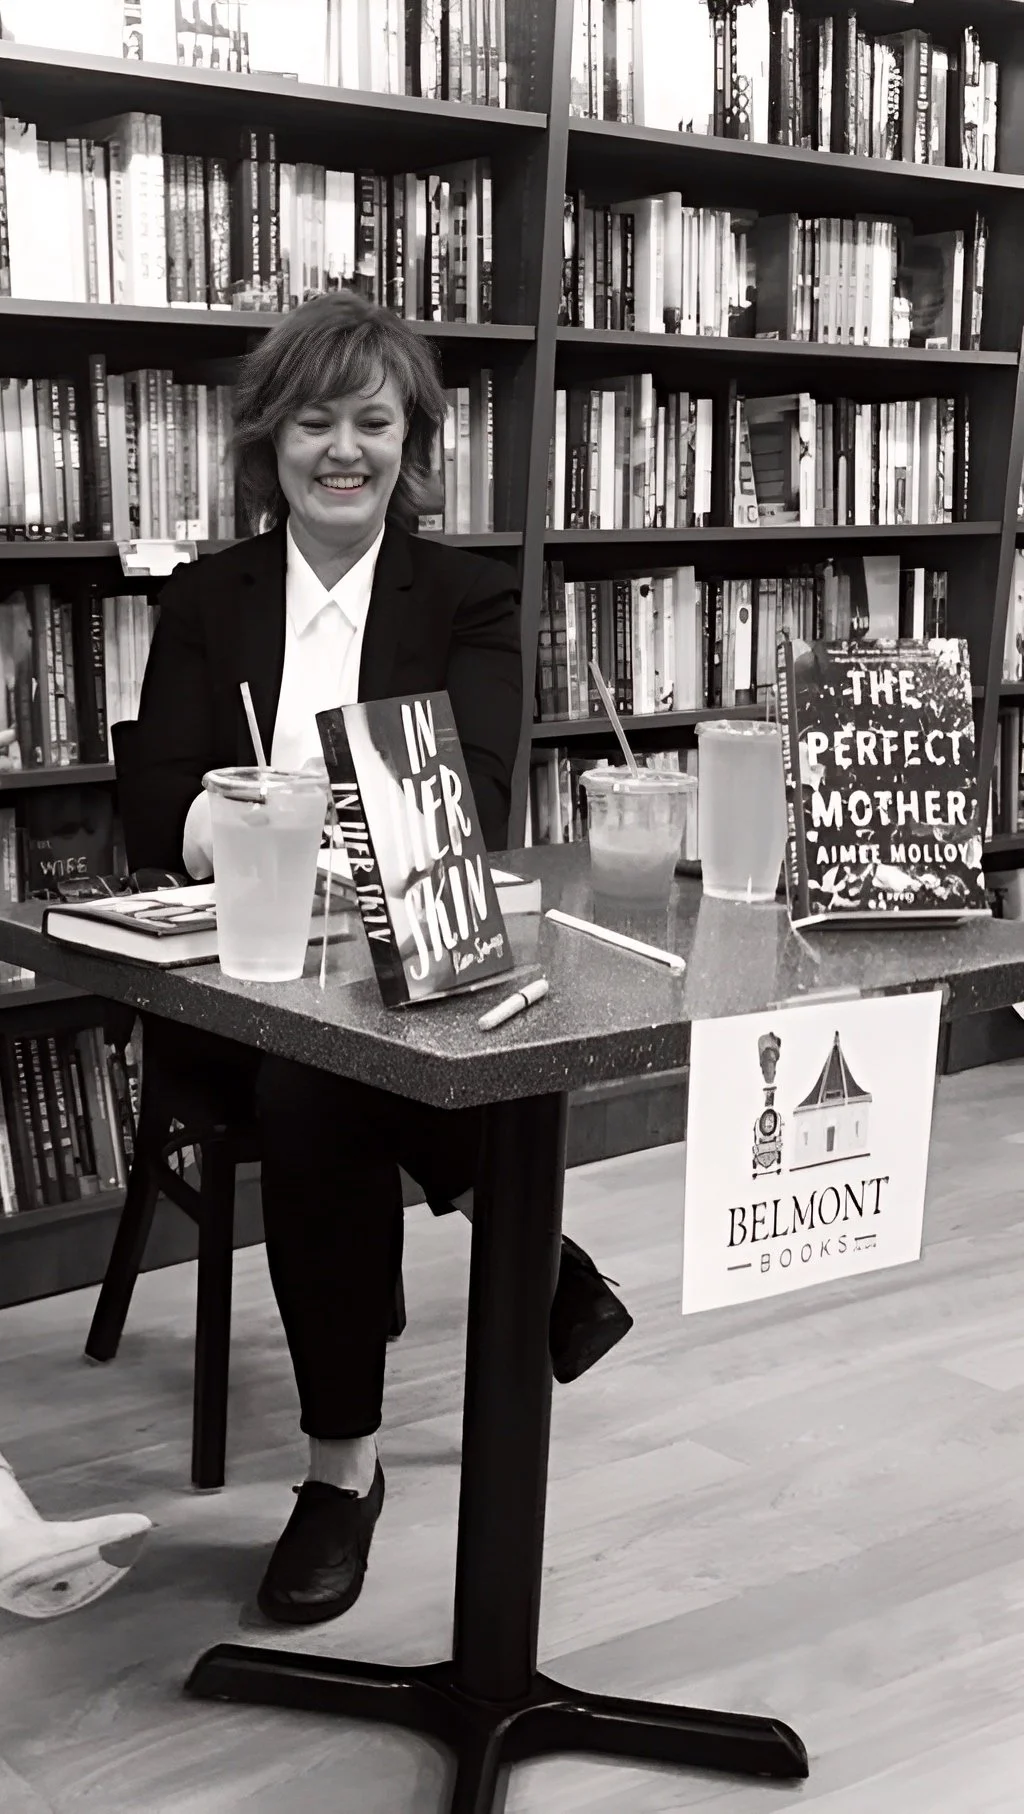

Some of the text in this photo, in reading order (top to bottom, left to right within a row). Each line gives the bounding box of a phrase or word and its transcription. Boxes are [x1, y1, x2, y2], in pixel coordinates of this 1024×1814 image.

[847, 669, 923, 710] THE
[400, 699, 438, 775] IN
[807, 729, 964, 770] PERFECT
[330, 782, 361, 810] IN
[811, 790, 968, 829] MOTHER
[816, 842, 969, 864] AIMEE MOLLOY
[403, 854, 489, 981] SKIN
[727, 1175, 890, 1248] BELMONT
[760, 1234, 849, 1274] BOOKS
